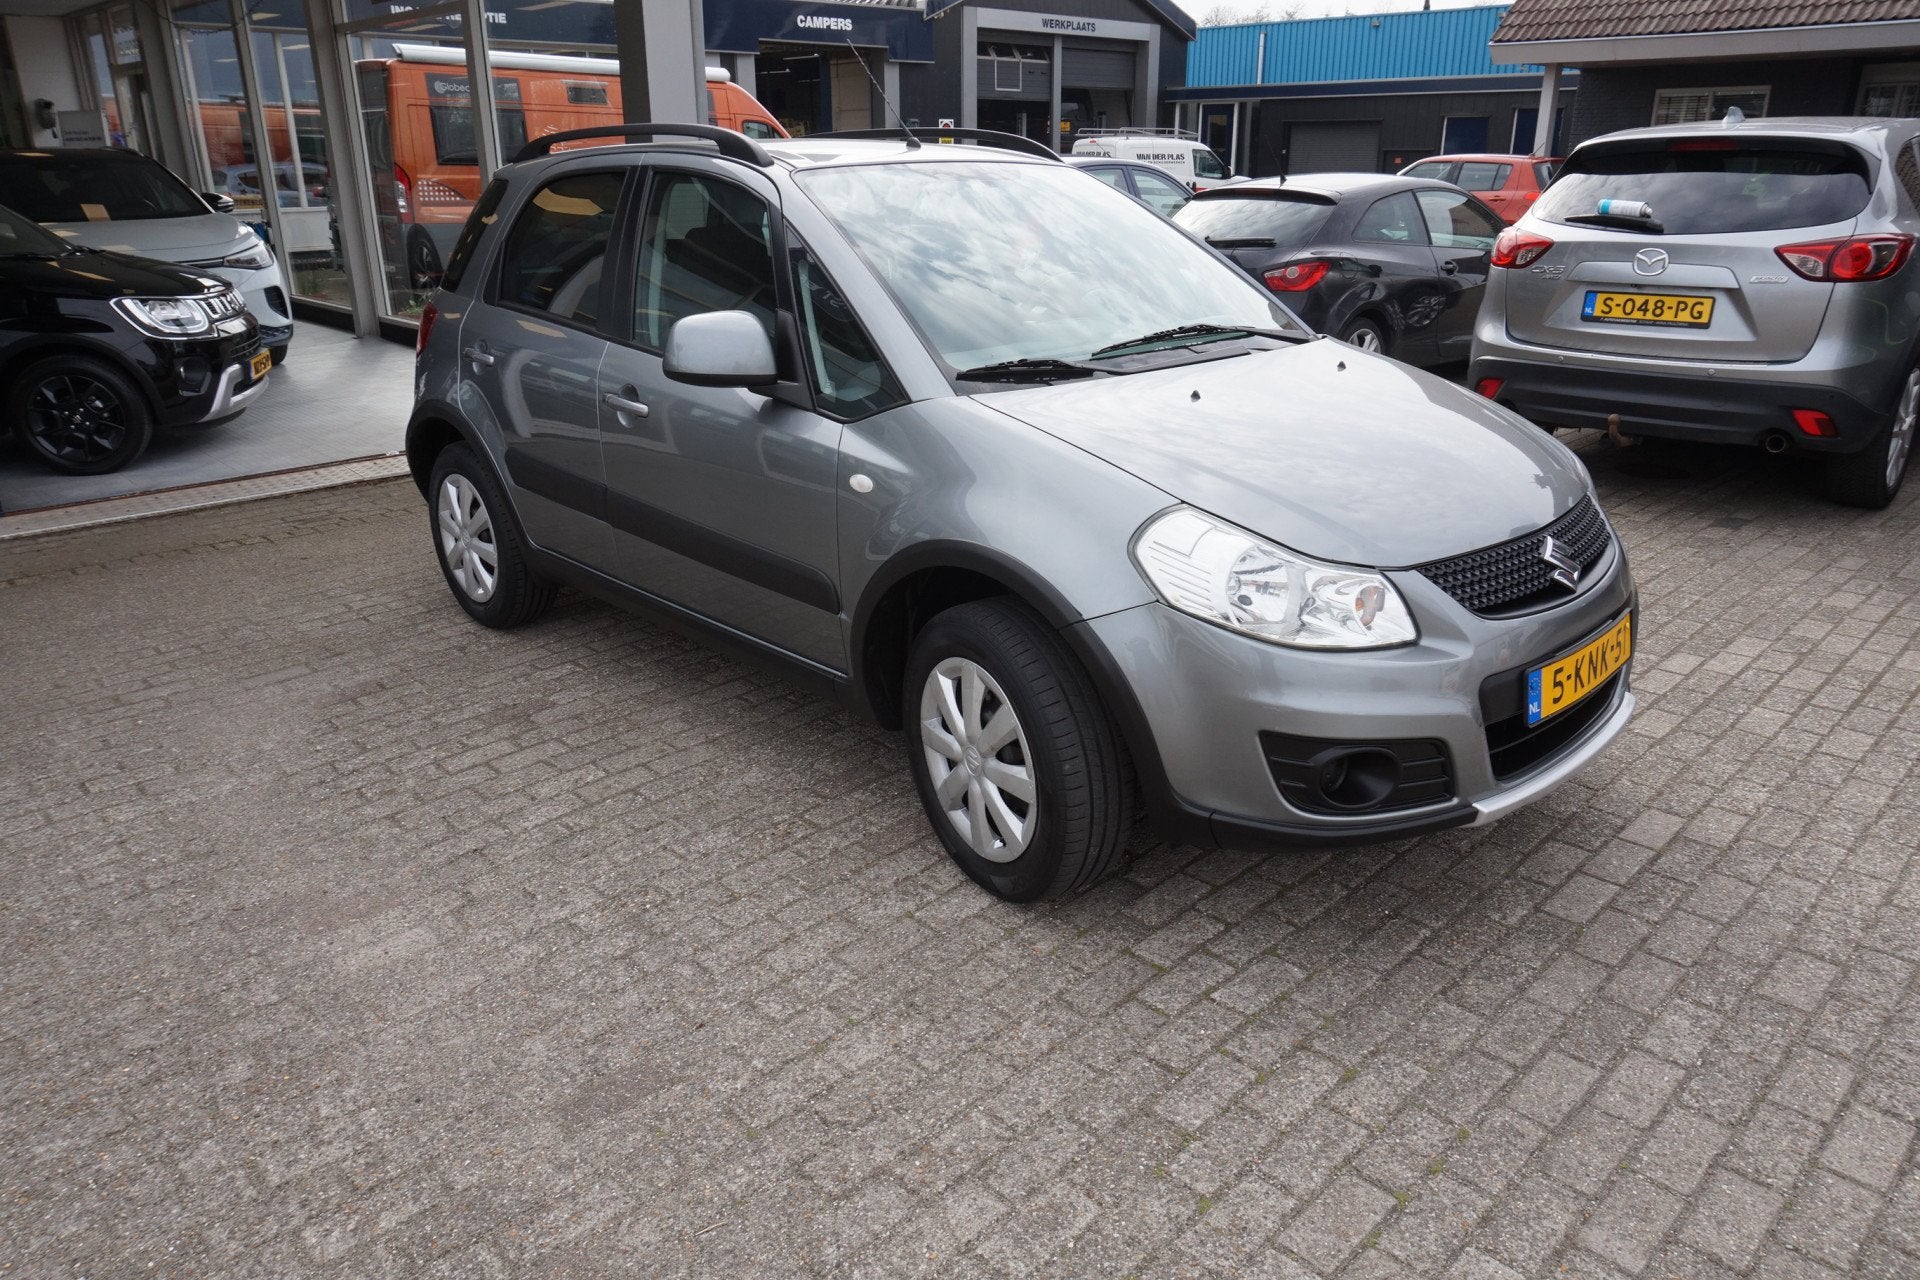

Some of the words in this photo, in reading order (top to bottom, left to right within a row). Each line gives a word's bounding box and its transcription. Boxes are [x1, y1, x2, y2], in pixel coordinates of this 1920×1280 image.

[796, 14, 853, 31] CAMPERS
[1041, 18, 1096, 32] WERKPLAATS
[1600, 297, 1705, 320] S-048-PG
[1552, 625, 1629, 705] 5-KNK-51
[1528, 701, 1541, 715] NL
